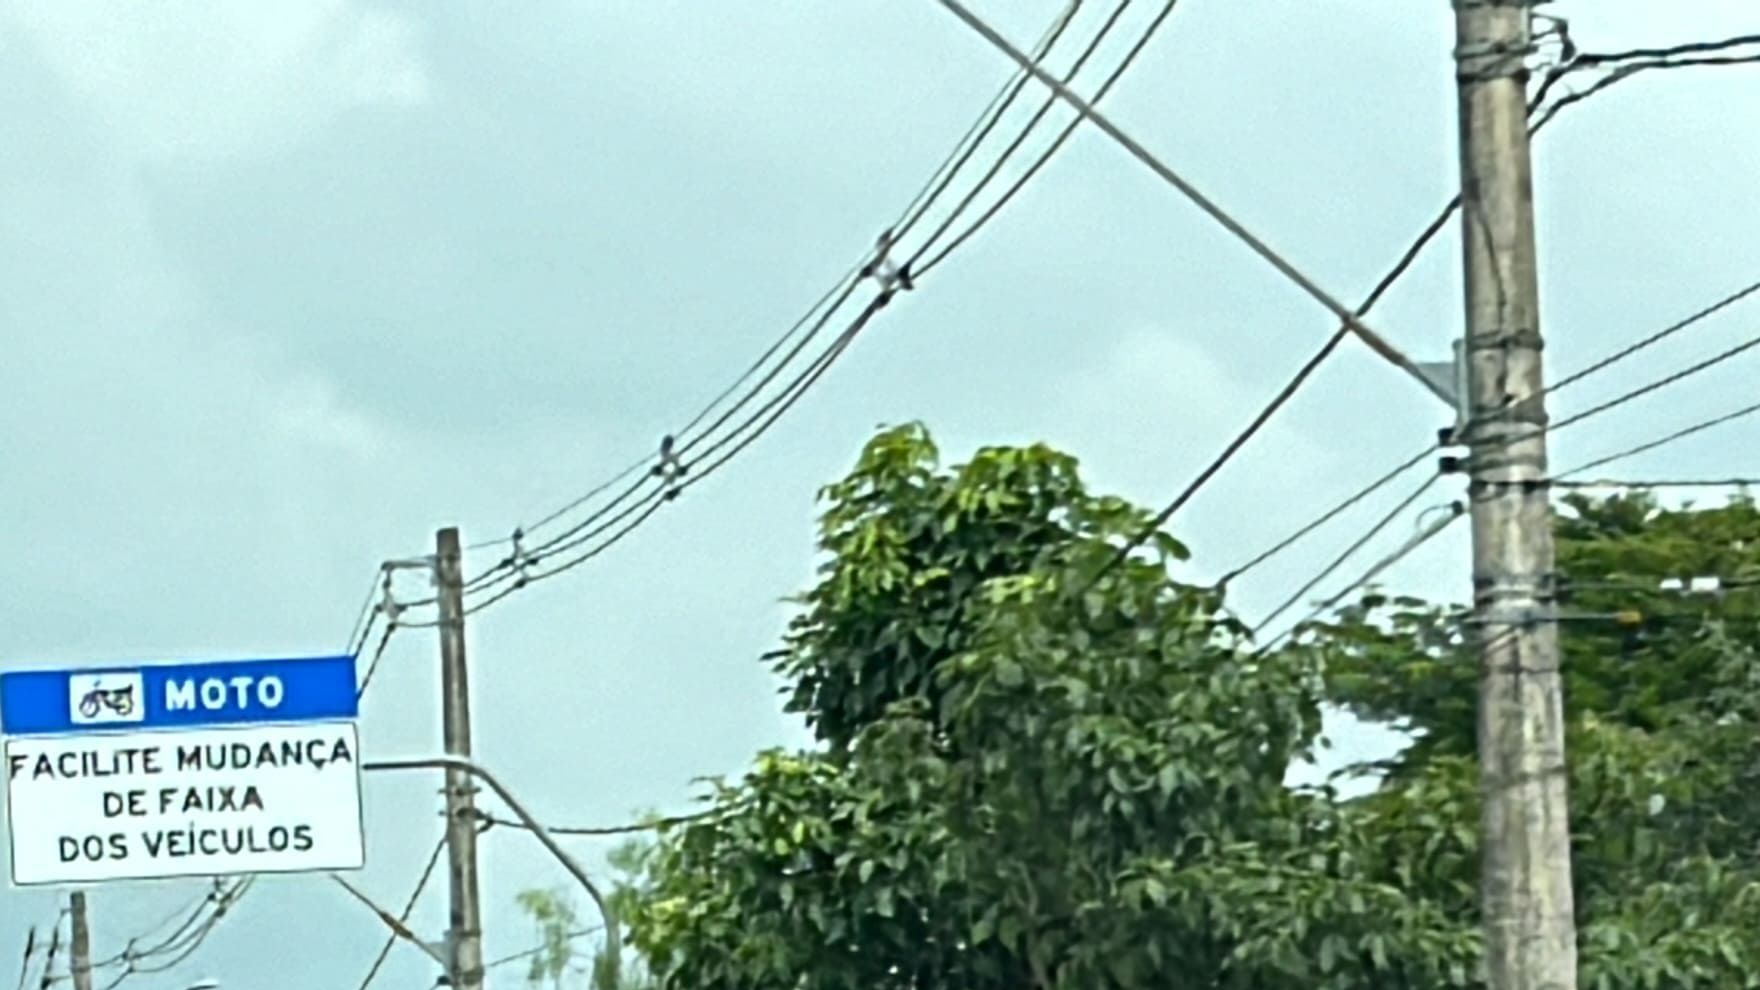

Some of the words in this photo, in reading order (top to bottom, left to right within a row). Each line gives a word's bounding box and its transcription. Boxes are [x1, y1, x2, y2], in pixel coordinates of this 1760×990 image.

[165, 676, 284, 711] MOTO
[9, 747, 162, 780] FACILITE
[177, 737, 352, 770] MUDANÇA
[103, 790, 147, 817] DE
[159, 786, 264, 814] FAIXA
[59, 834, 128, 862] DOS
[142, 821, 313, 858] VEÍCULOS
